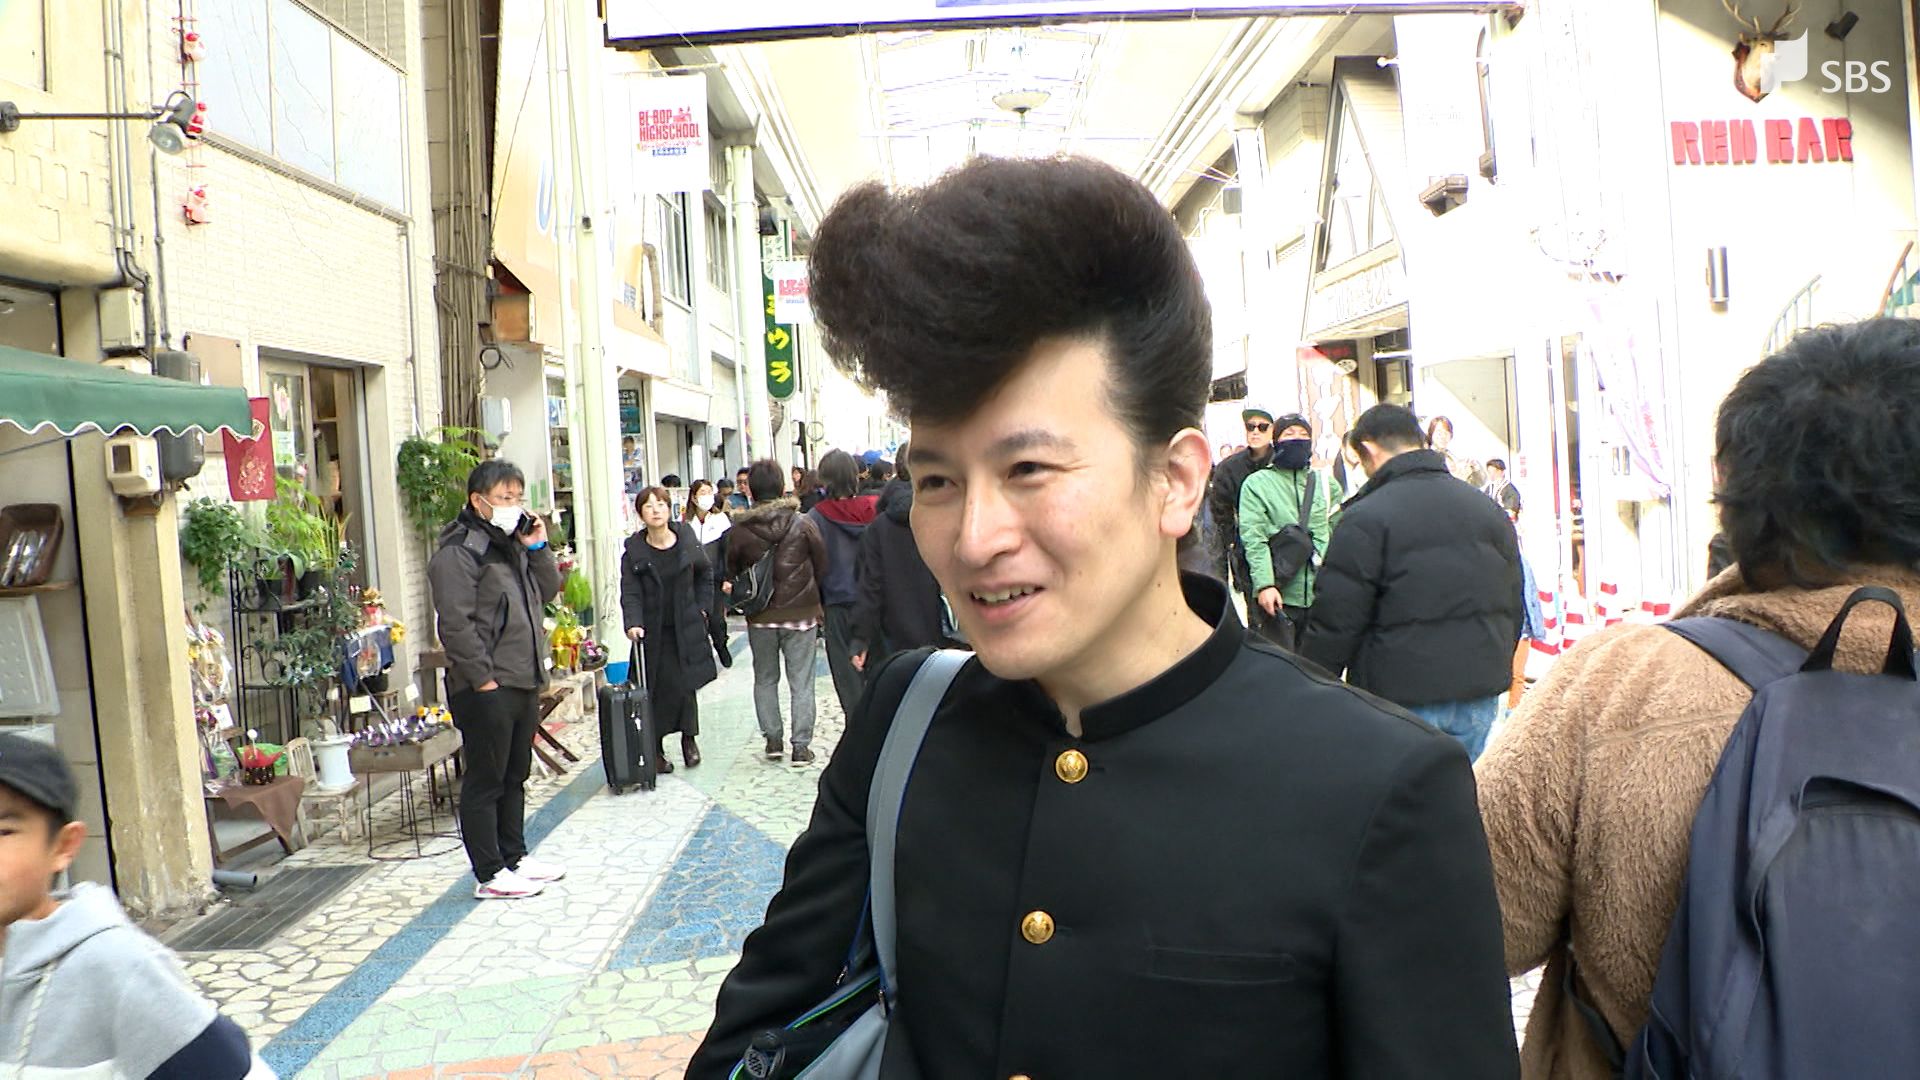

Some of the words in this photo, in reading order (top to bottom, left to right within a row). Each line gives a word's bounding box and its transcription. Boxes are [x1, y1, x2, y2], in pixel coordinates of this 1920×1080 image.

[639, 123, 701, 142] HIGHSCHOOL
[1671, 120, 1757, 165] RED
[1765, 117, 1854, 164] BAR
